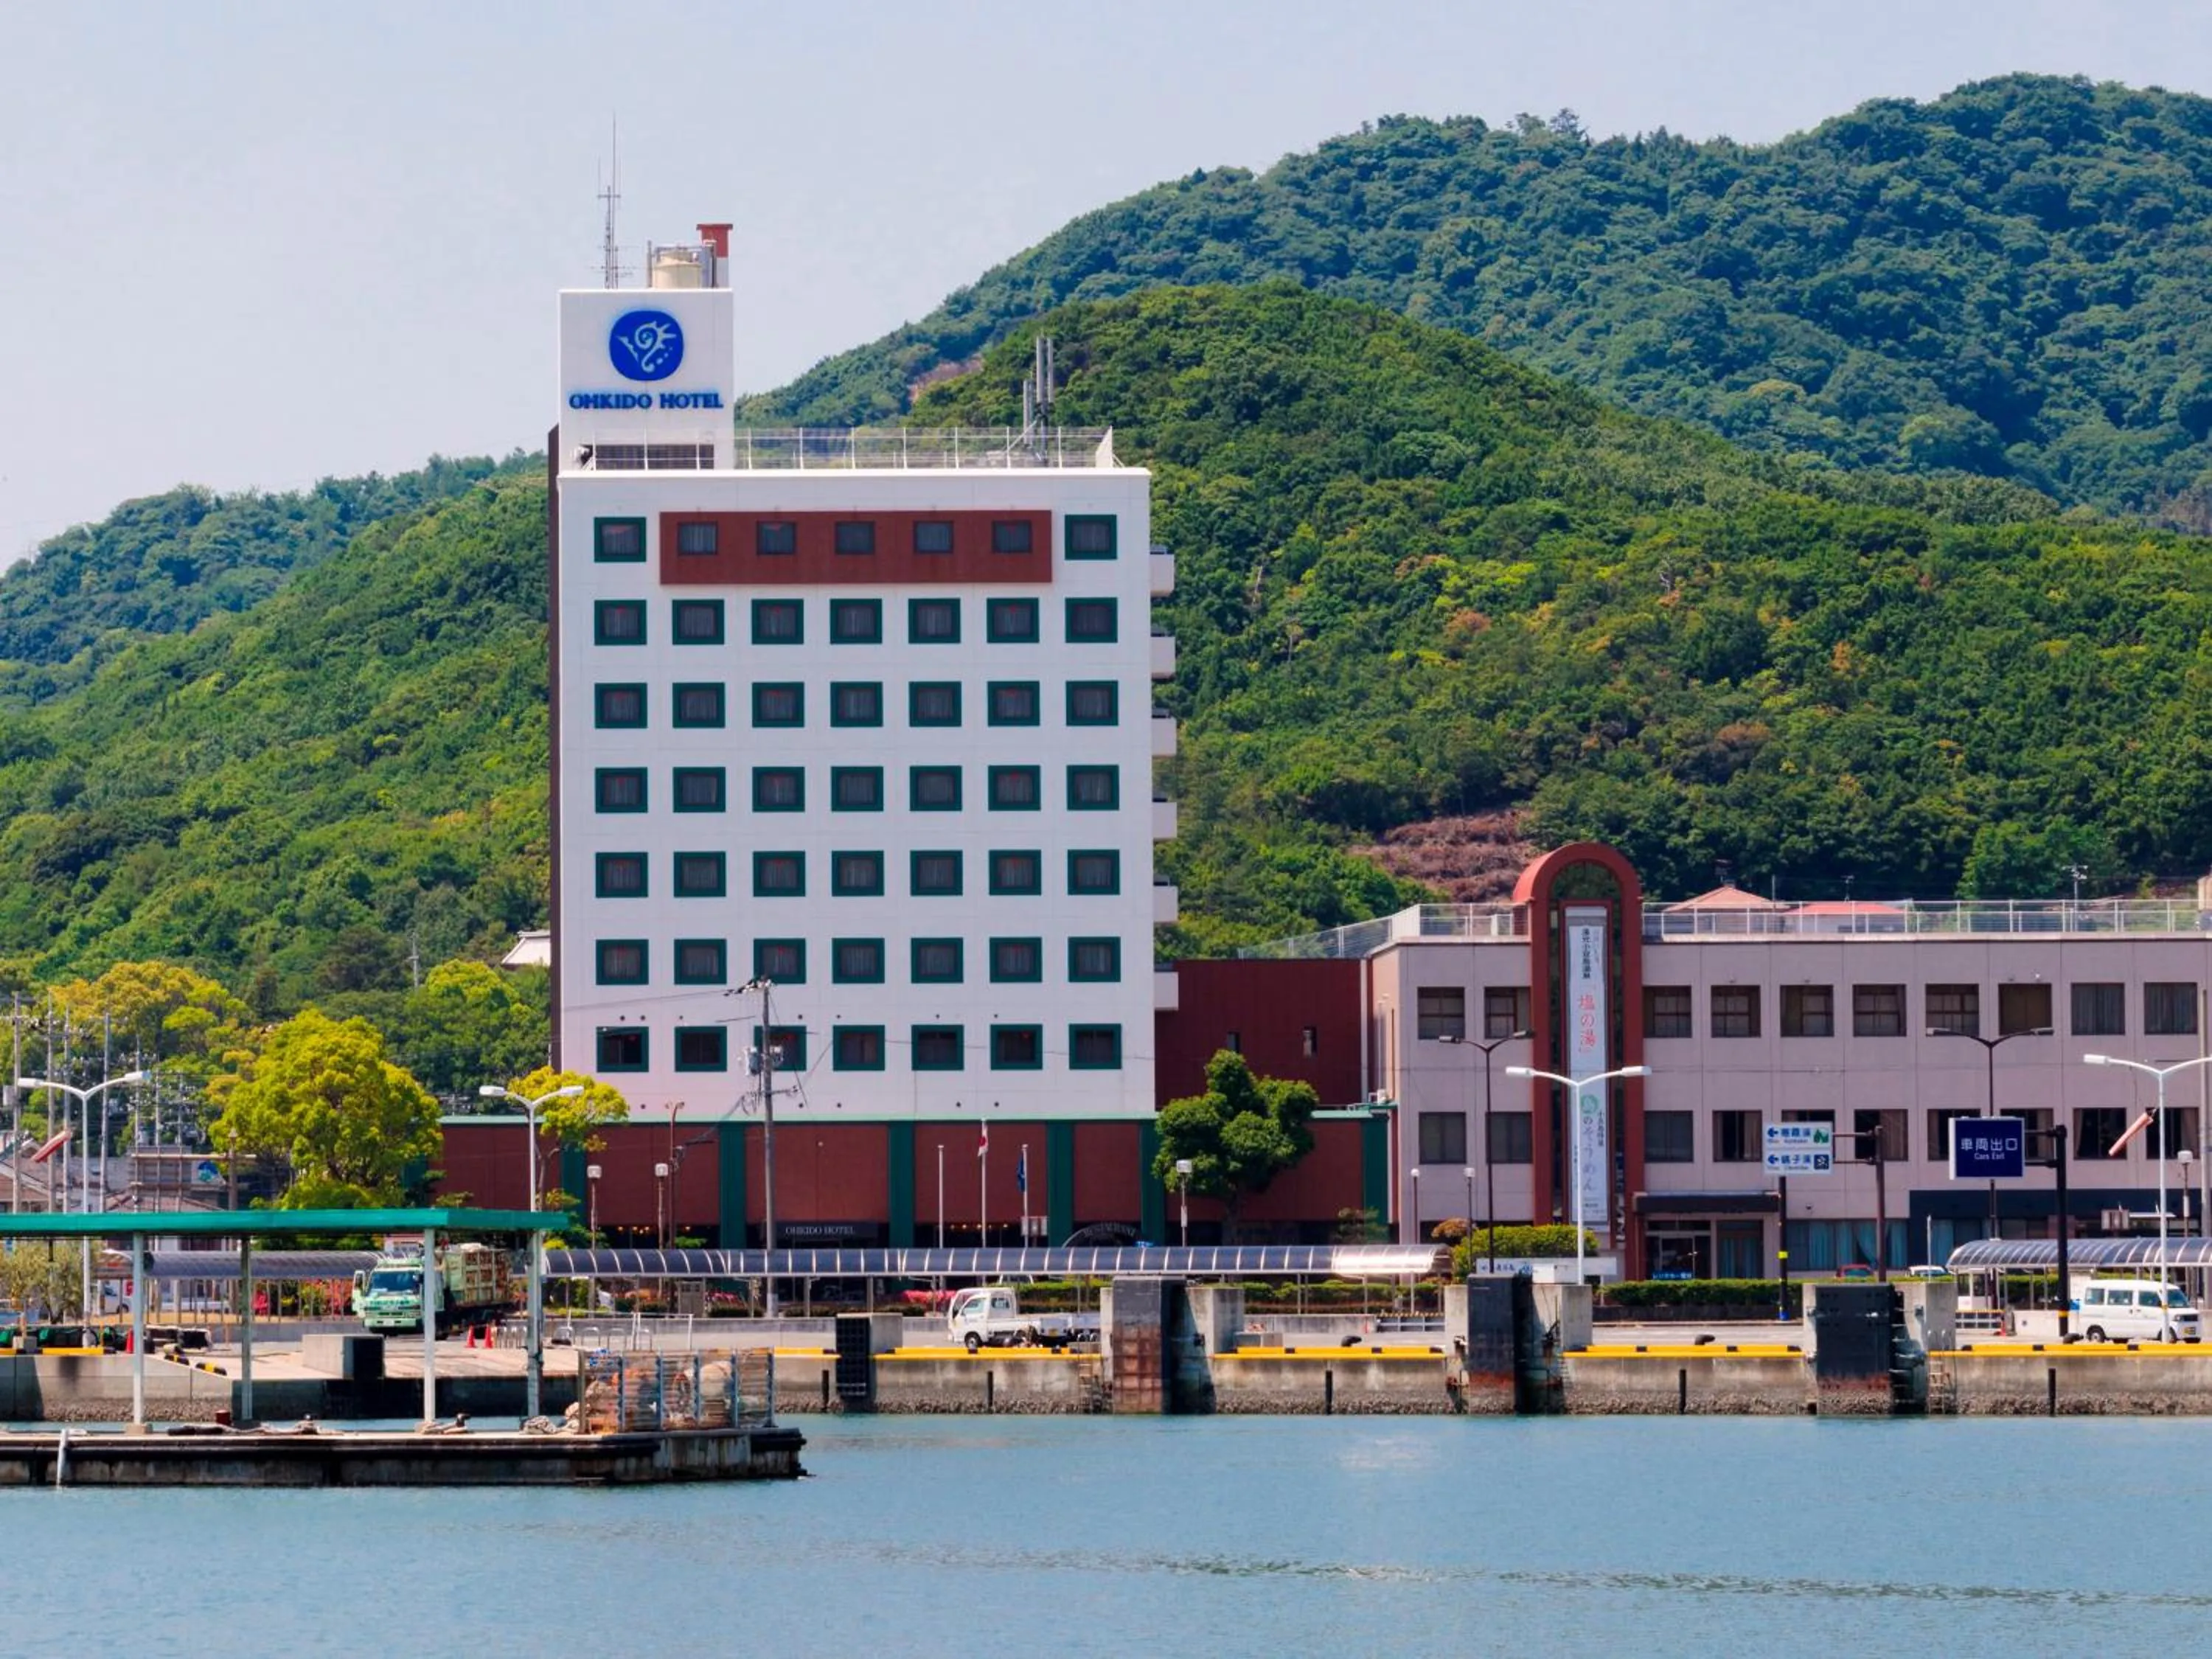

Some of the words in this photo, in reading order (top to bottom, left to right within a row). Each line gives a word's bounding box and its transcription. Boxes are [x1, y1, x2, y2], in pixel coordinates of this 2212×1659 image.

[569, 394, 653, 409] OHKIDO
[659, 393, 724, 408] HOTEL
[1961, 1138, 2018, 1151] 車両出口
[824, 1226, 855, 1234] HOTEL
